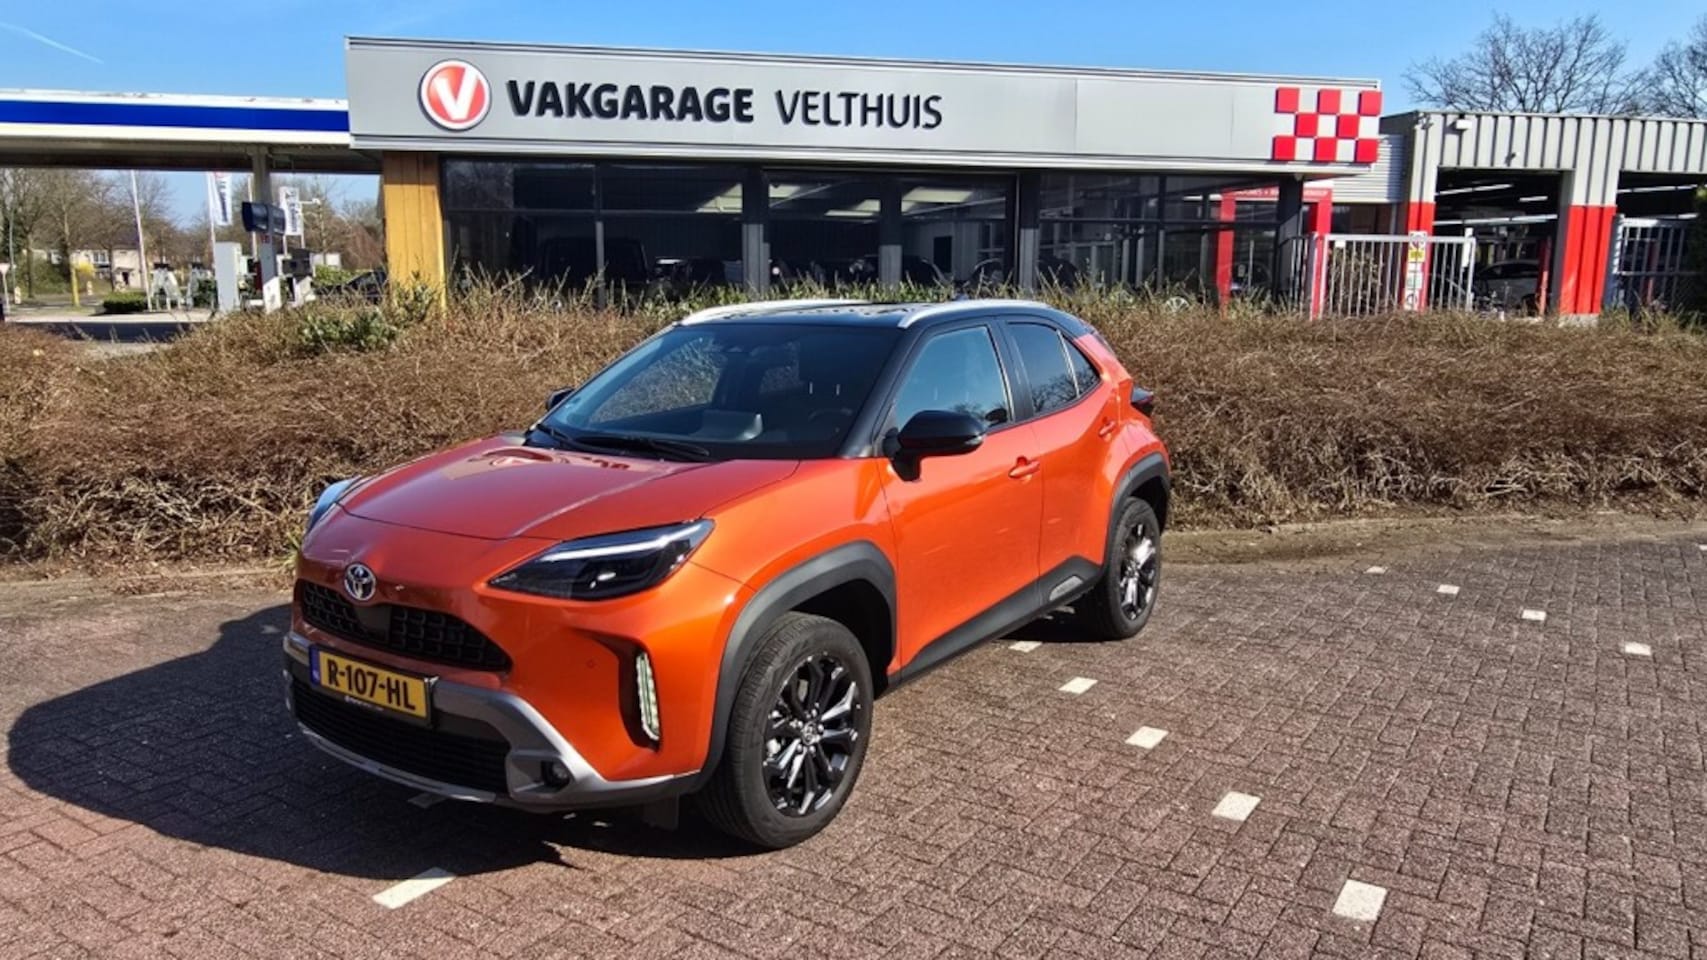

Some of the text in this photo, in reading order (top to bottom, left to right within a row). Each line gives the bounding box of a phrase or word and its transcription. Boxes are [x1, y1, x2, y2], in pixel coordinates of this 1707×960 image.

[506, 79, 943, 130] VAKGARAGE VELTHUIS
[326, 658, 417, 711] R-107-HL
